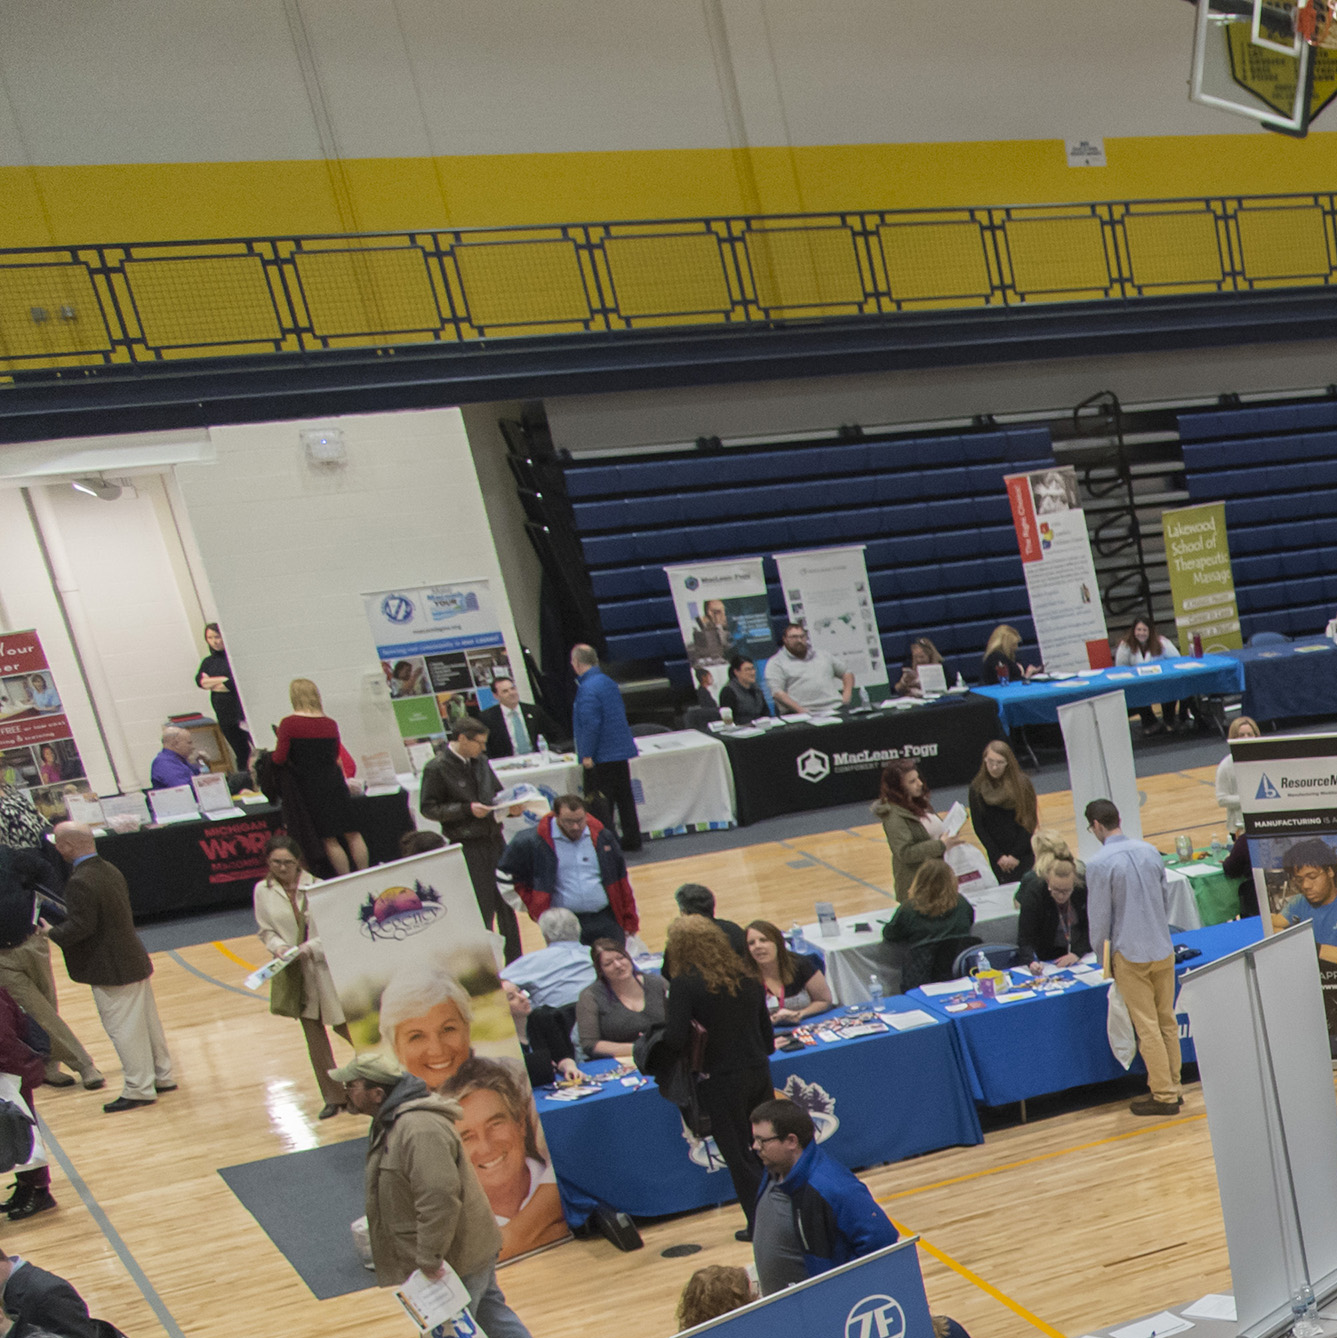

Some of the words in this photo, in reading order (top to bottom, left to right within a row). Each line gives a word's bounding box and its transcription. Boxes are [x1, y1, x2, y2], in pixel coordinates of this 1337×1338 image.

[1167, 516, 1216, 538] Lakewood
[1172, 538, 1203, 557] School
[1204, 534, 1218, 549] of
[1175, 552, 1228, 571] Therapeutic
[1193, 570, 1232, 585] Massage
[1, 725, 21, 736] FREE
[833, 743, 938, 766] MacLean-Fogg
[1254, 817, 1321, 828] MANUFACTURING
[1323, 816, 1331, 824] IS
